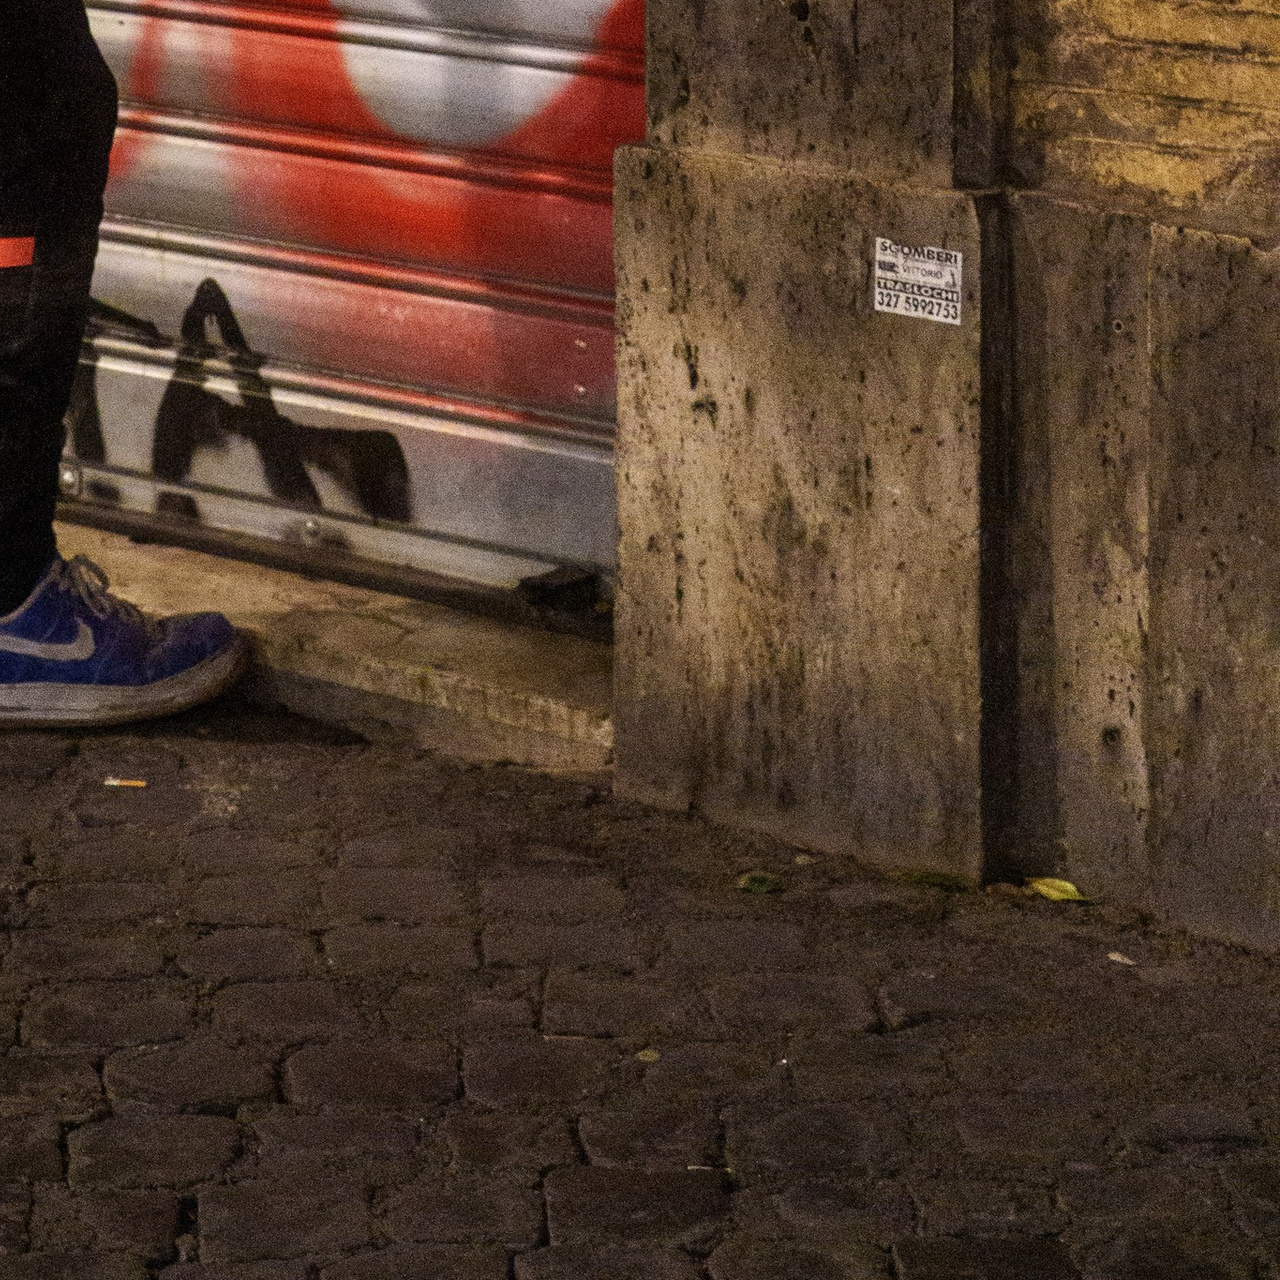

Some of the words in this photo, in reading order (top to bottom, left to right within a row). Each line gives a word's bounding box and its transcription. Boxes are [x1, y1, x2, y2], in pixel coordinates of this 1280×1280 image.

[880, 240, 958, 265] SGOMBERI
[877, 291, 901, 309] 327
[904, 296, 958, 320] 5992753
